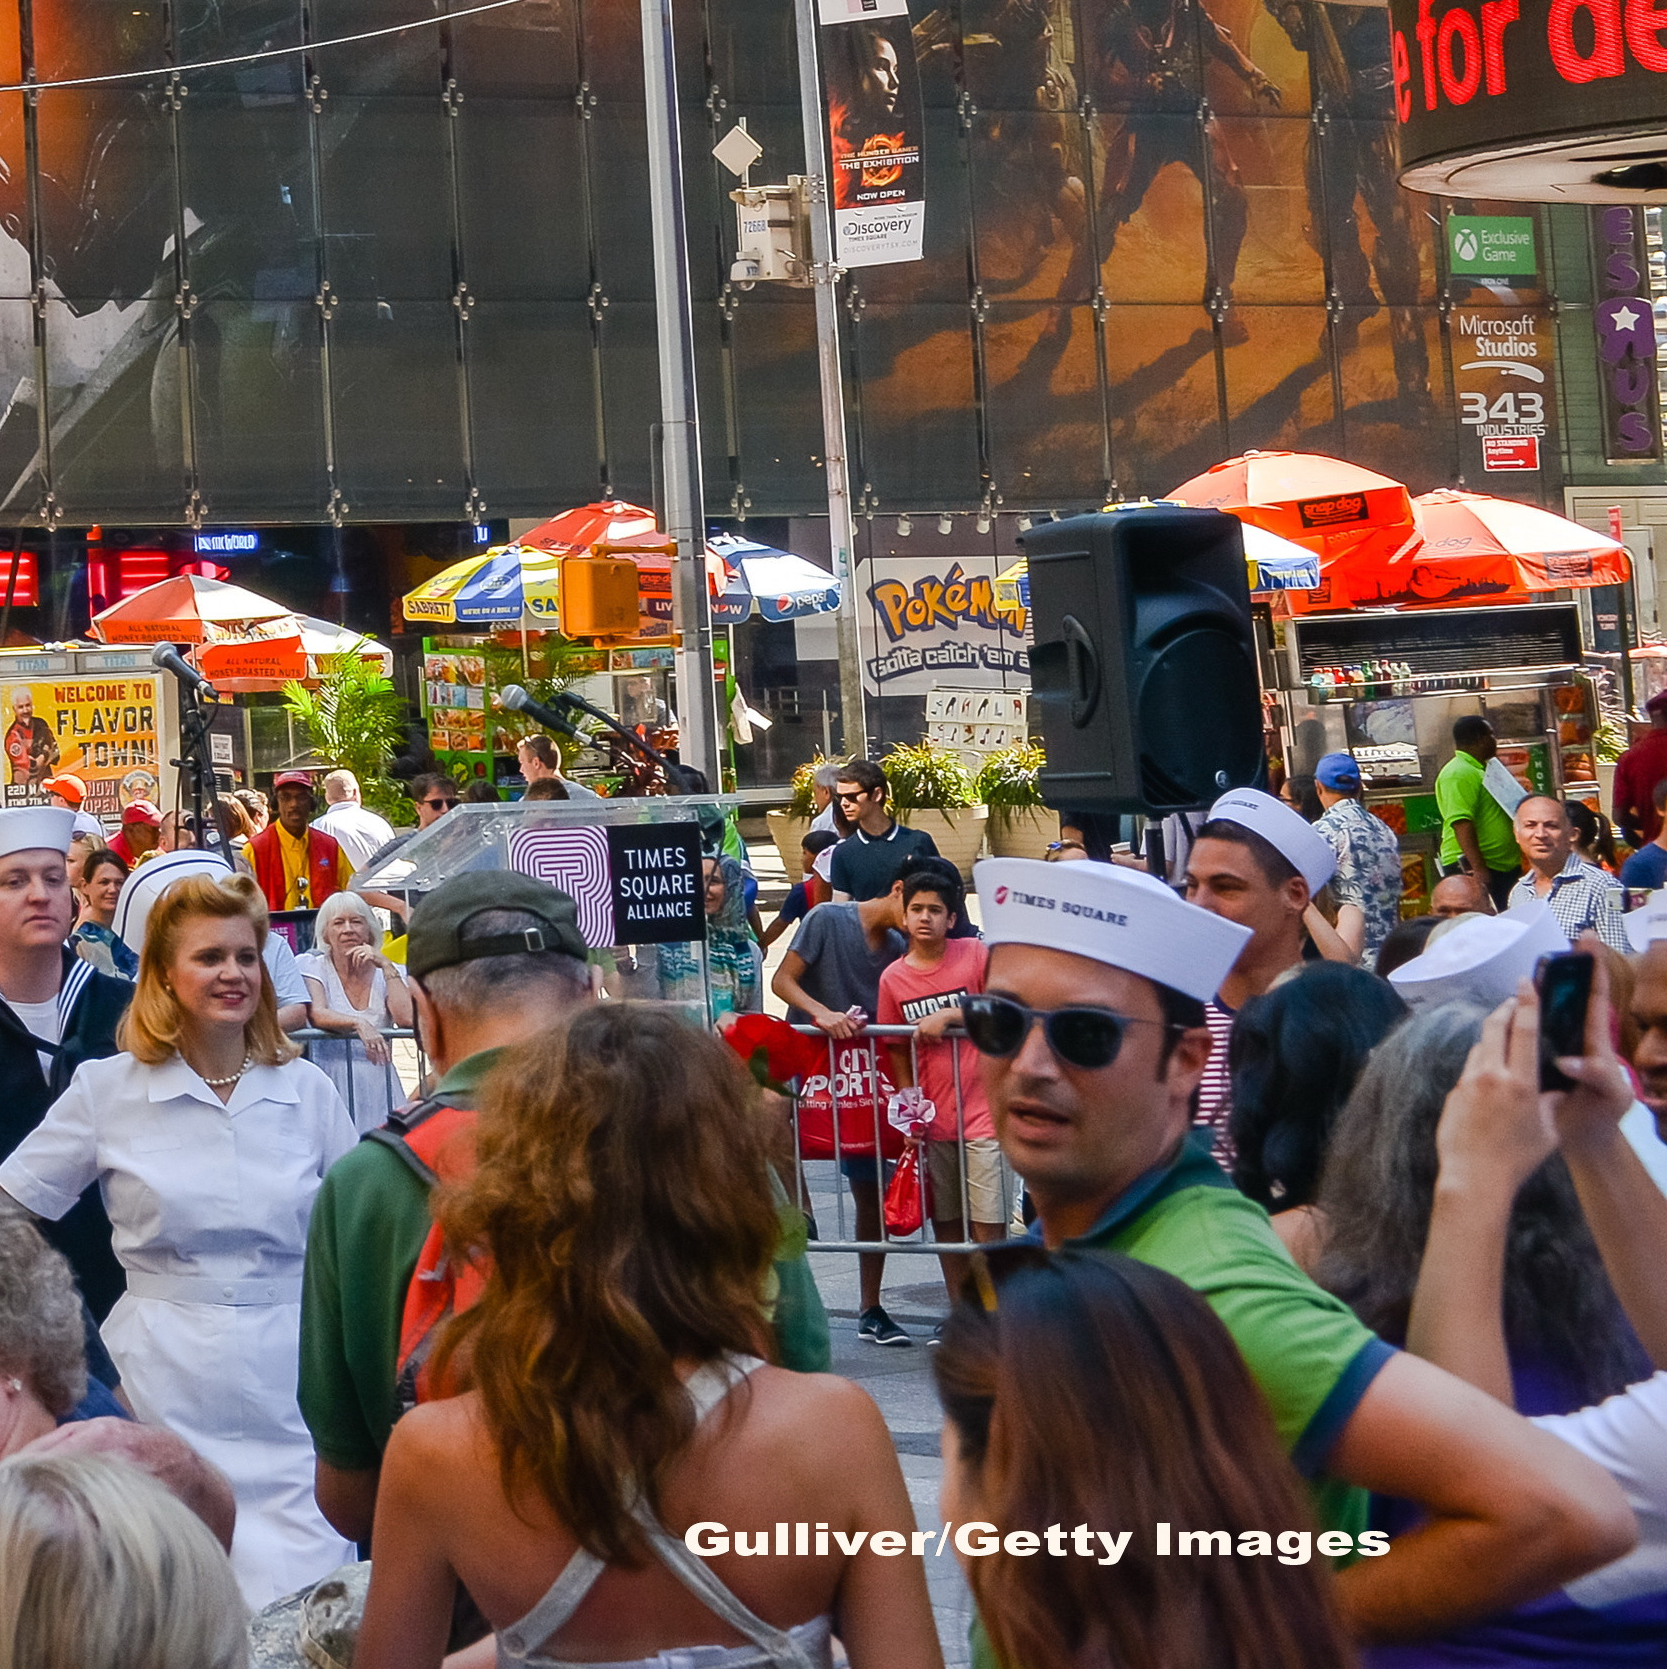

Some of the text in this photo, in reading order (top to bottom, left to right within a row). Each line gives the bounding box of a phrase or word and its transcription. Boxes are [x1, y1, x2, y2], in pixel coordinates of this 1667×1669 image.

[840, 155, 920, 170] THE EXHIBITION
[857, 190, 906, 200] NOW OPEN
[846, 219, 912, 236] Discovery
[1481, 230, 1530, 245] Exclusive
[1482, 249, 1516, 262] Game
[1460, 315, 1535, 336] Microsoft
[1476, 337, 1537, 357] Studios
[1460, 392, 1544, 424] 343
[1476, 424, 1546, 436] INDUSTRIES
[1304, 497, 1362, 514] snap dog
[796, 590, 827, 609] pepsi
[407, 599, 451, 618] SABRETT
[144, 624, 181, 632] NATURAL
[16, 658, 49, 671] TITAN
[103, 655, 136, 667] TITAN
[870, 647, 920, 680] Gotta
[925, 642, 980, 666] catch
[279, 668, 301, 677] NUTS
[54, 682, 152, 703] WELCOME TO
[55, 705, 155, 736] FLAVOR
[78, 738, 155, 769] TOWN!
[7, 785, 26, 796] 220
[86, 780, 115, 796] NOW
[85, 797, 119, 813] OPEN
[624, 847, 687, 870] TIMES
[620, 874, 696, 900] SQUARE
[627, 902, 693, 920] ALLIANCE
[1011, 891, 1128, 926] TIMES SQUARE
